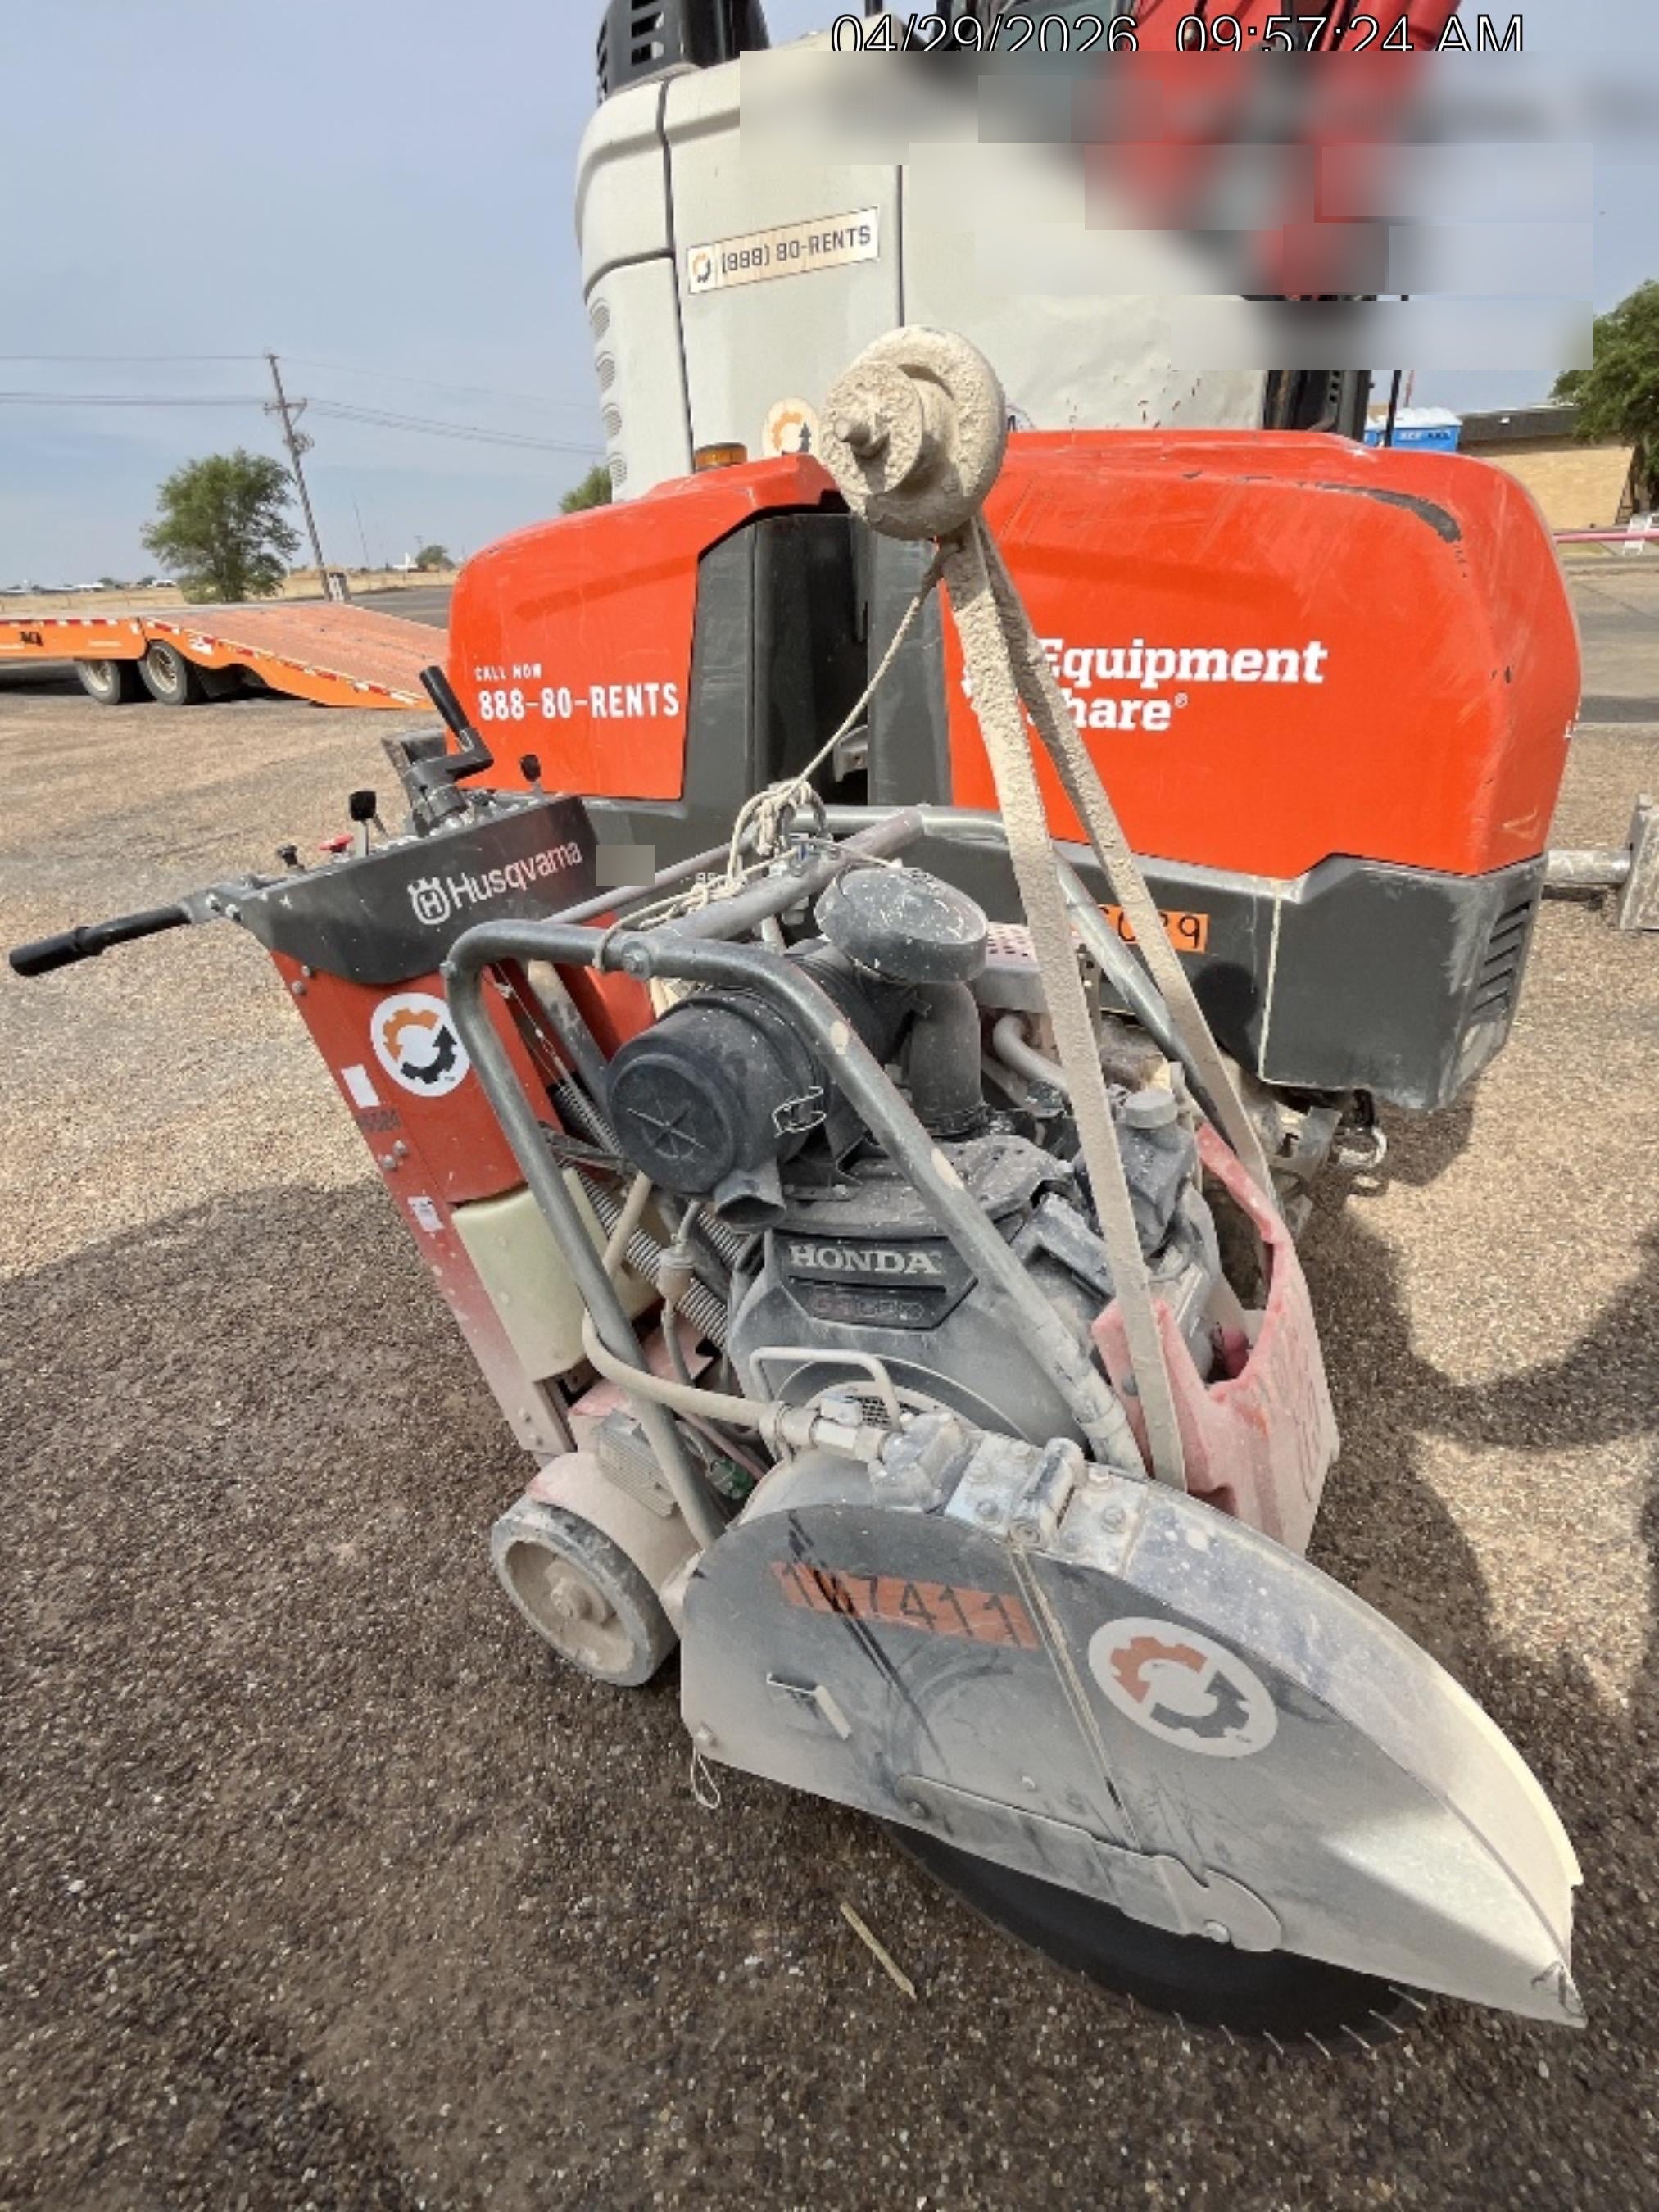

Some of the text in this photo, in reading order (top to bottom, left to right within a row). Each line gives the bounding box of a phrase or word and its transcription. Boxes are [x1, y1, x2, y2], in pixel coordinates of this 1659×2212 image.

[722, 225, 871, 274] (888) 80-RENTS
[475, 663, 542, 682] CALL NOW
[478, 682, 680, 722] 888-80-RENTS
[446, 842, 582, 910] Husqvarna
[789, 1245, 944, 1275] HONDA
